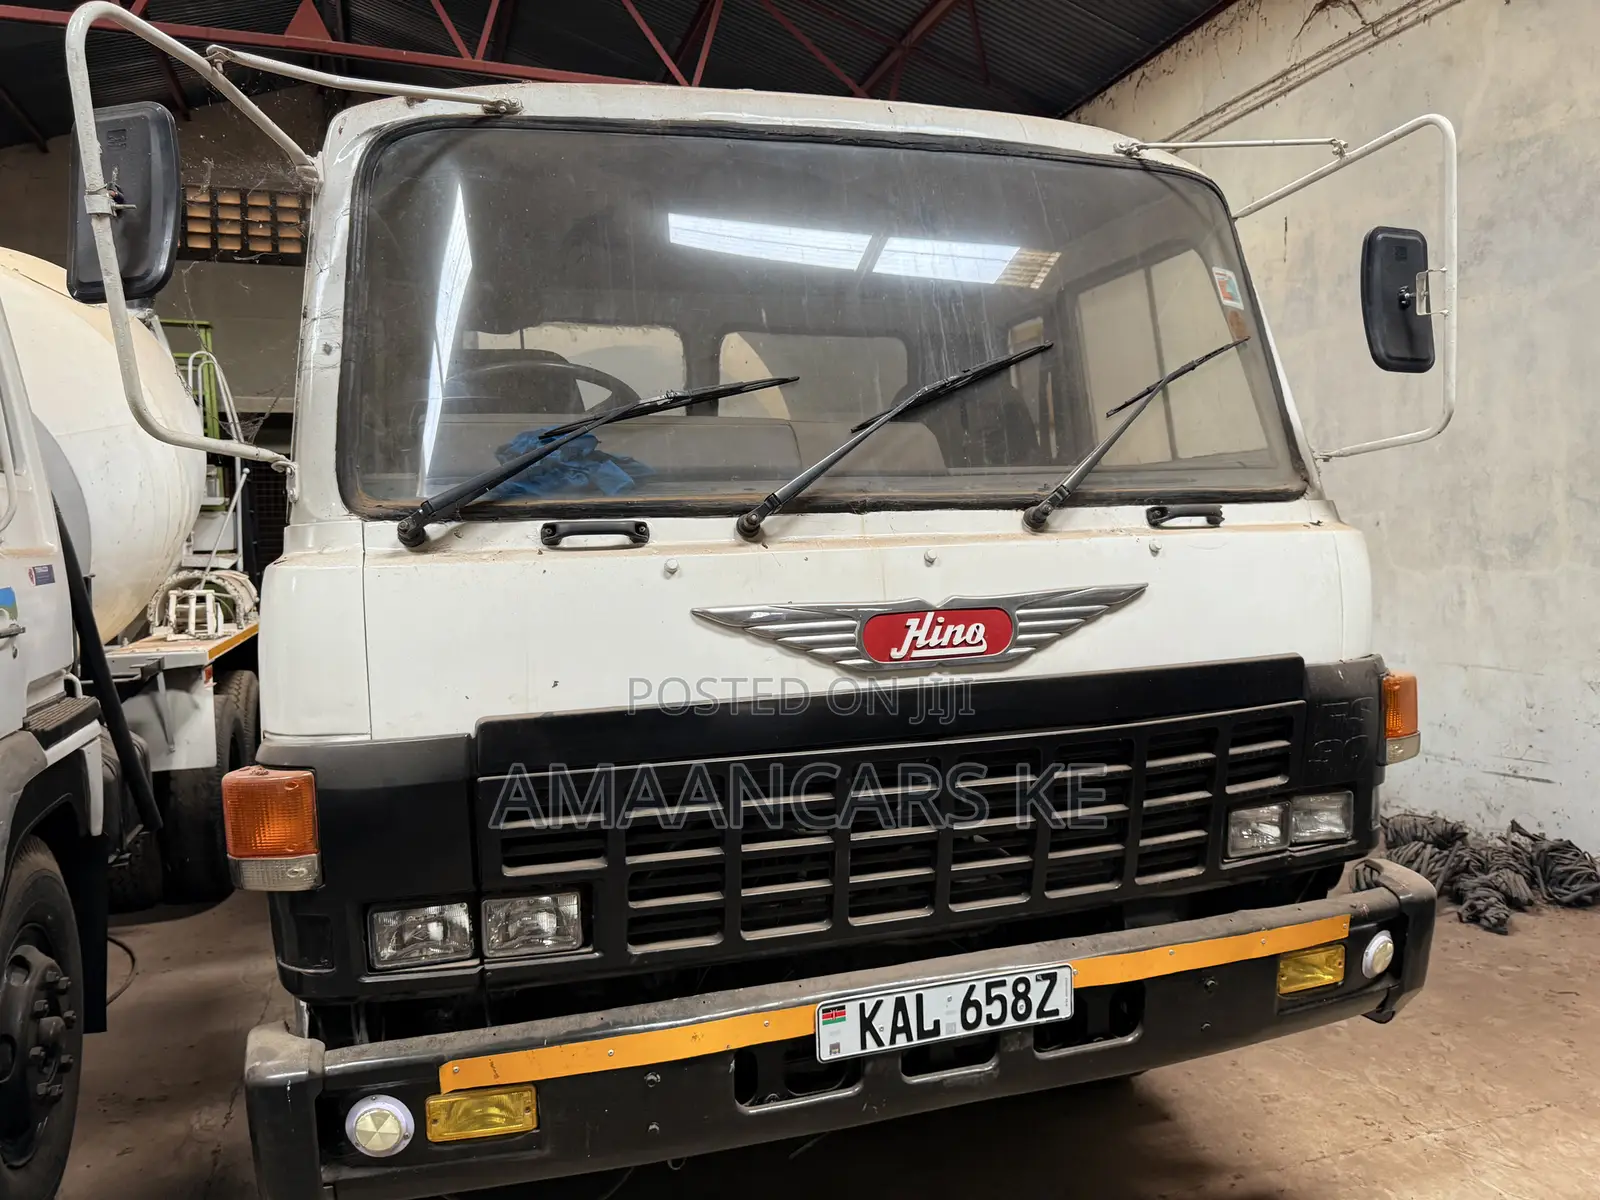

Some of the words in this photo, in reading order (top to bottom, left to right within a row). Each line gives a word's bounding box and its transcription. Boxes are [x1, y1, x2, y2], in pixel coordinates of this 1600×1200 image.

[890, 612, 987, 659] Hino
[859, 993, 941, 1050] KAL
[960, 972, 1060, 1031] 658Z
